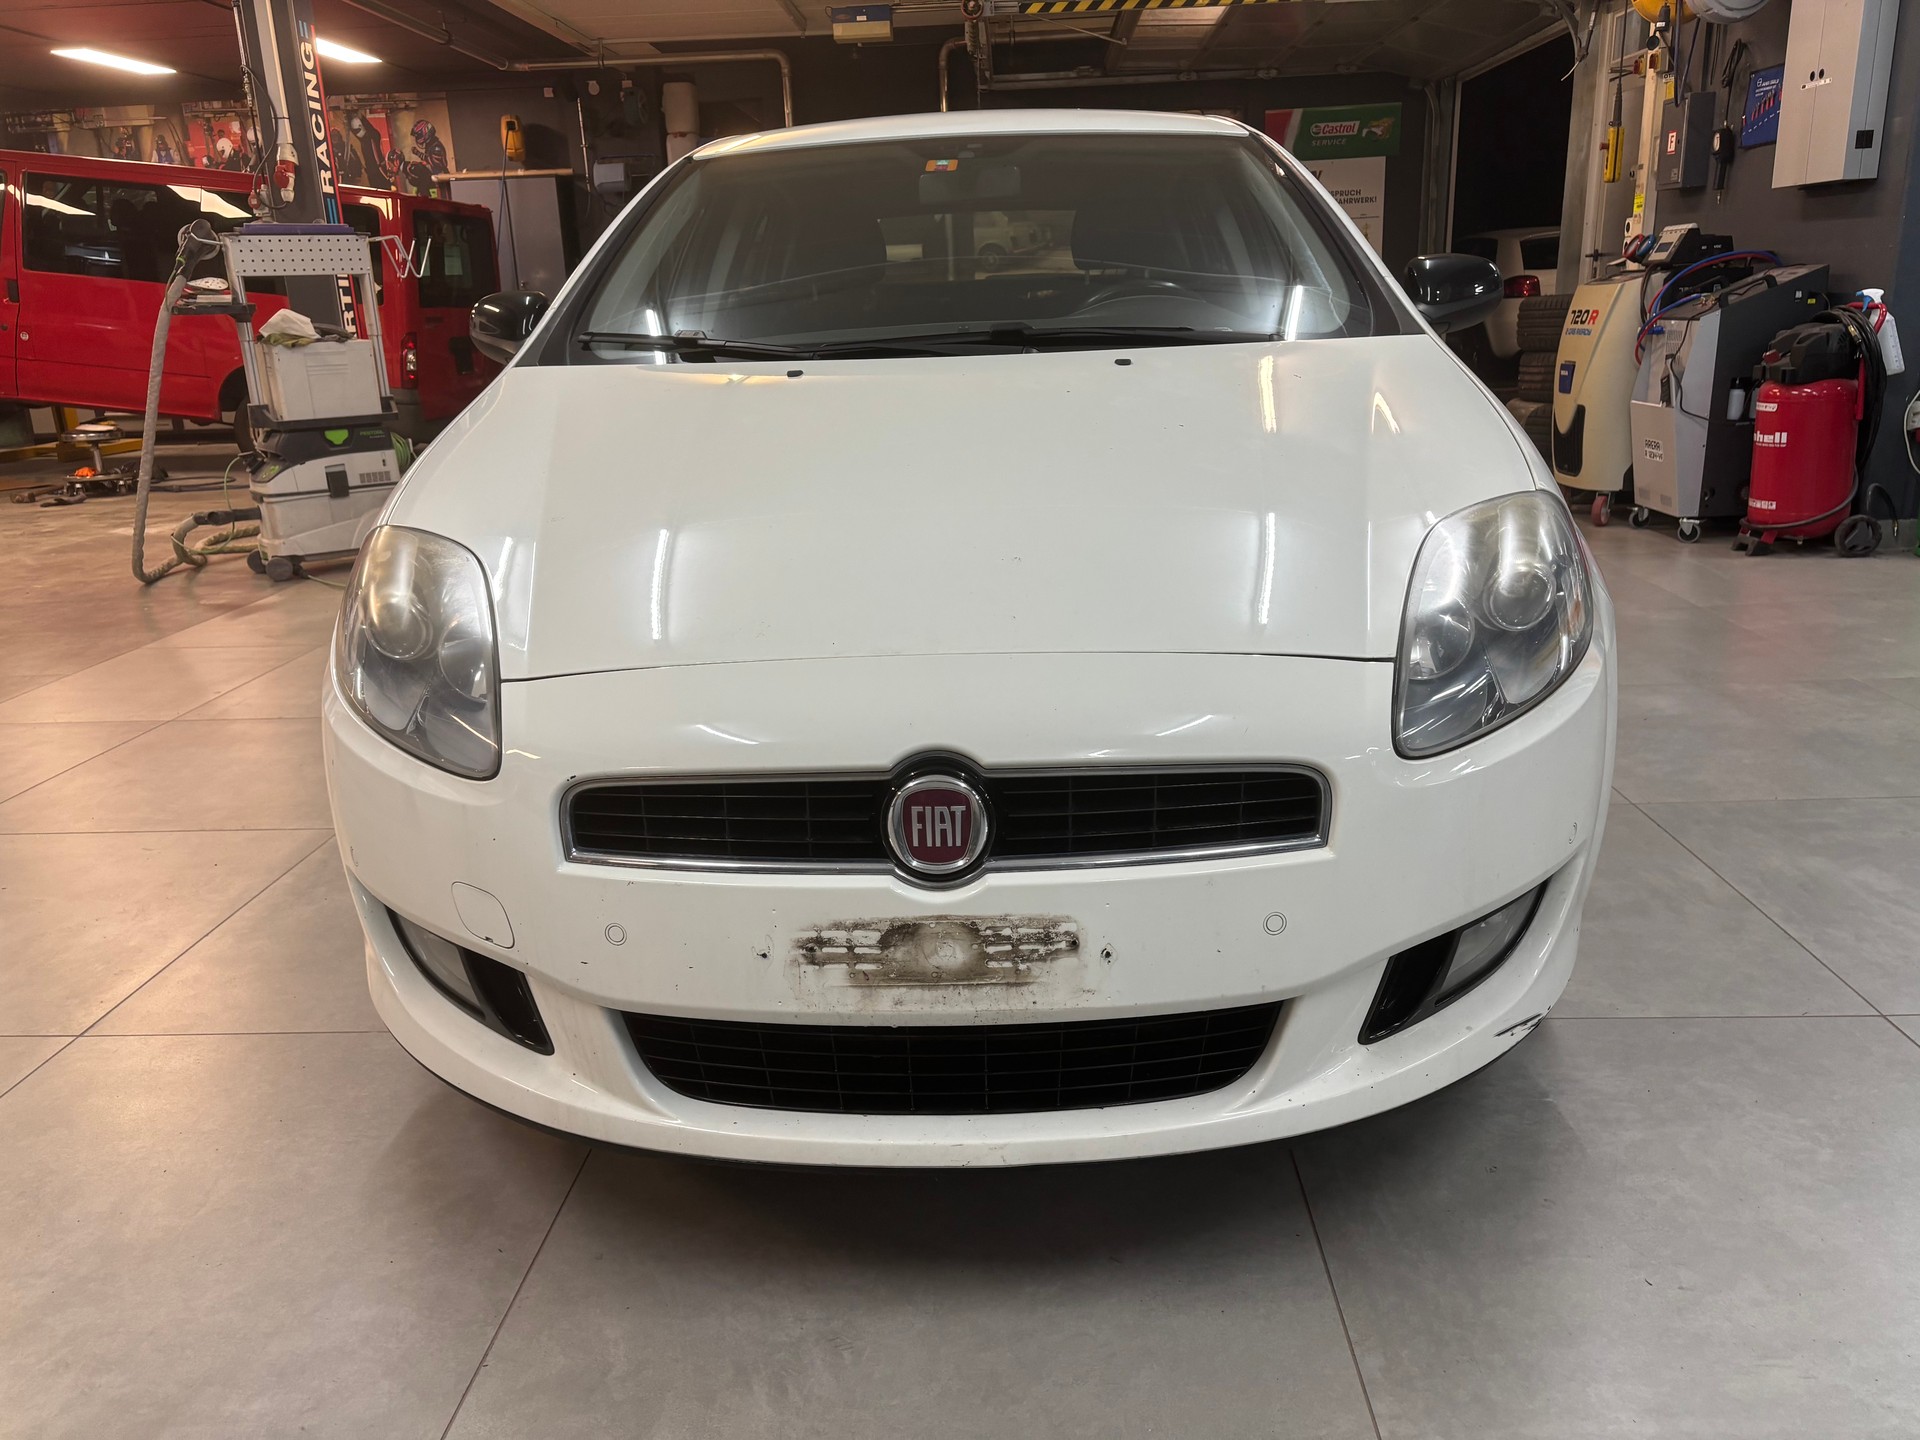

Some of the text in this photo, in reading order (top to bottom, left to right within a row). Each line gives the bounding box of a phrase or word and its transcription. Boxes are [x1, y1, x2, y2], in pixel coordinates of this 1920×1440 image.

[302, 41, 335, 194] RACING
[1321, 123, 1356, 135] Castrol
[1312, 138, 1347, 146] SERVICE
[1329, 189, 1362, 197] SPRUCH
[1336, 196, 1377, 205] AHRWERK!
[338, 274, 356, 335] RTI
[911, 805, 967, 847] FIAT
